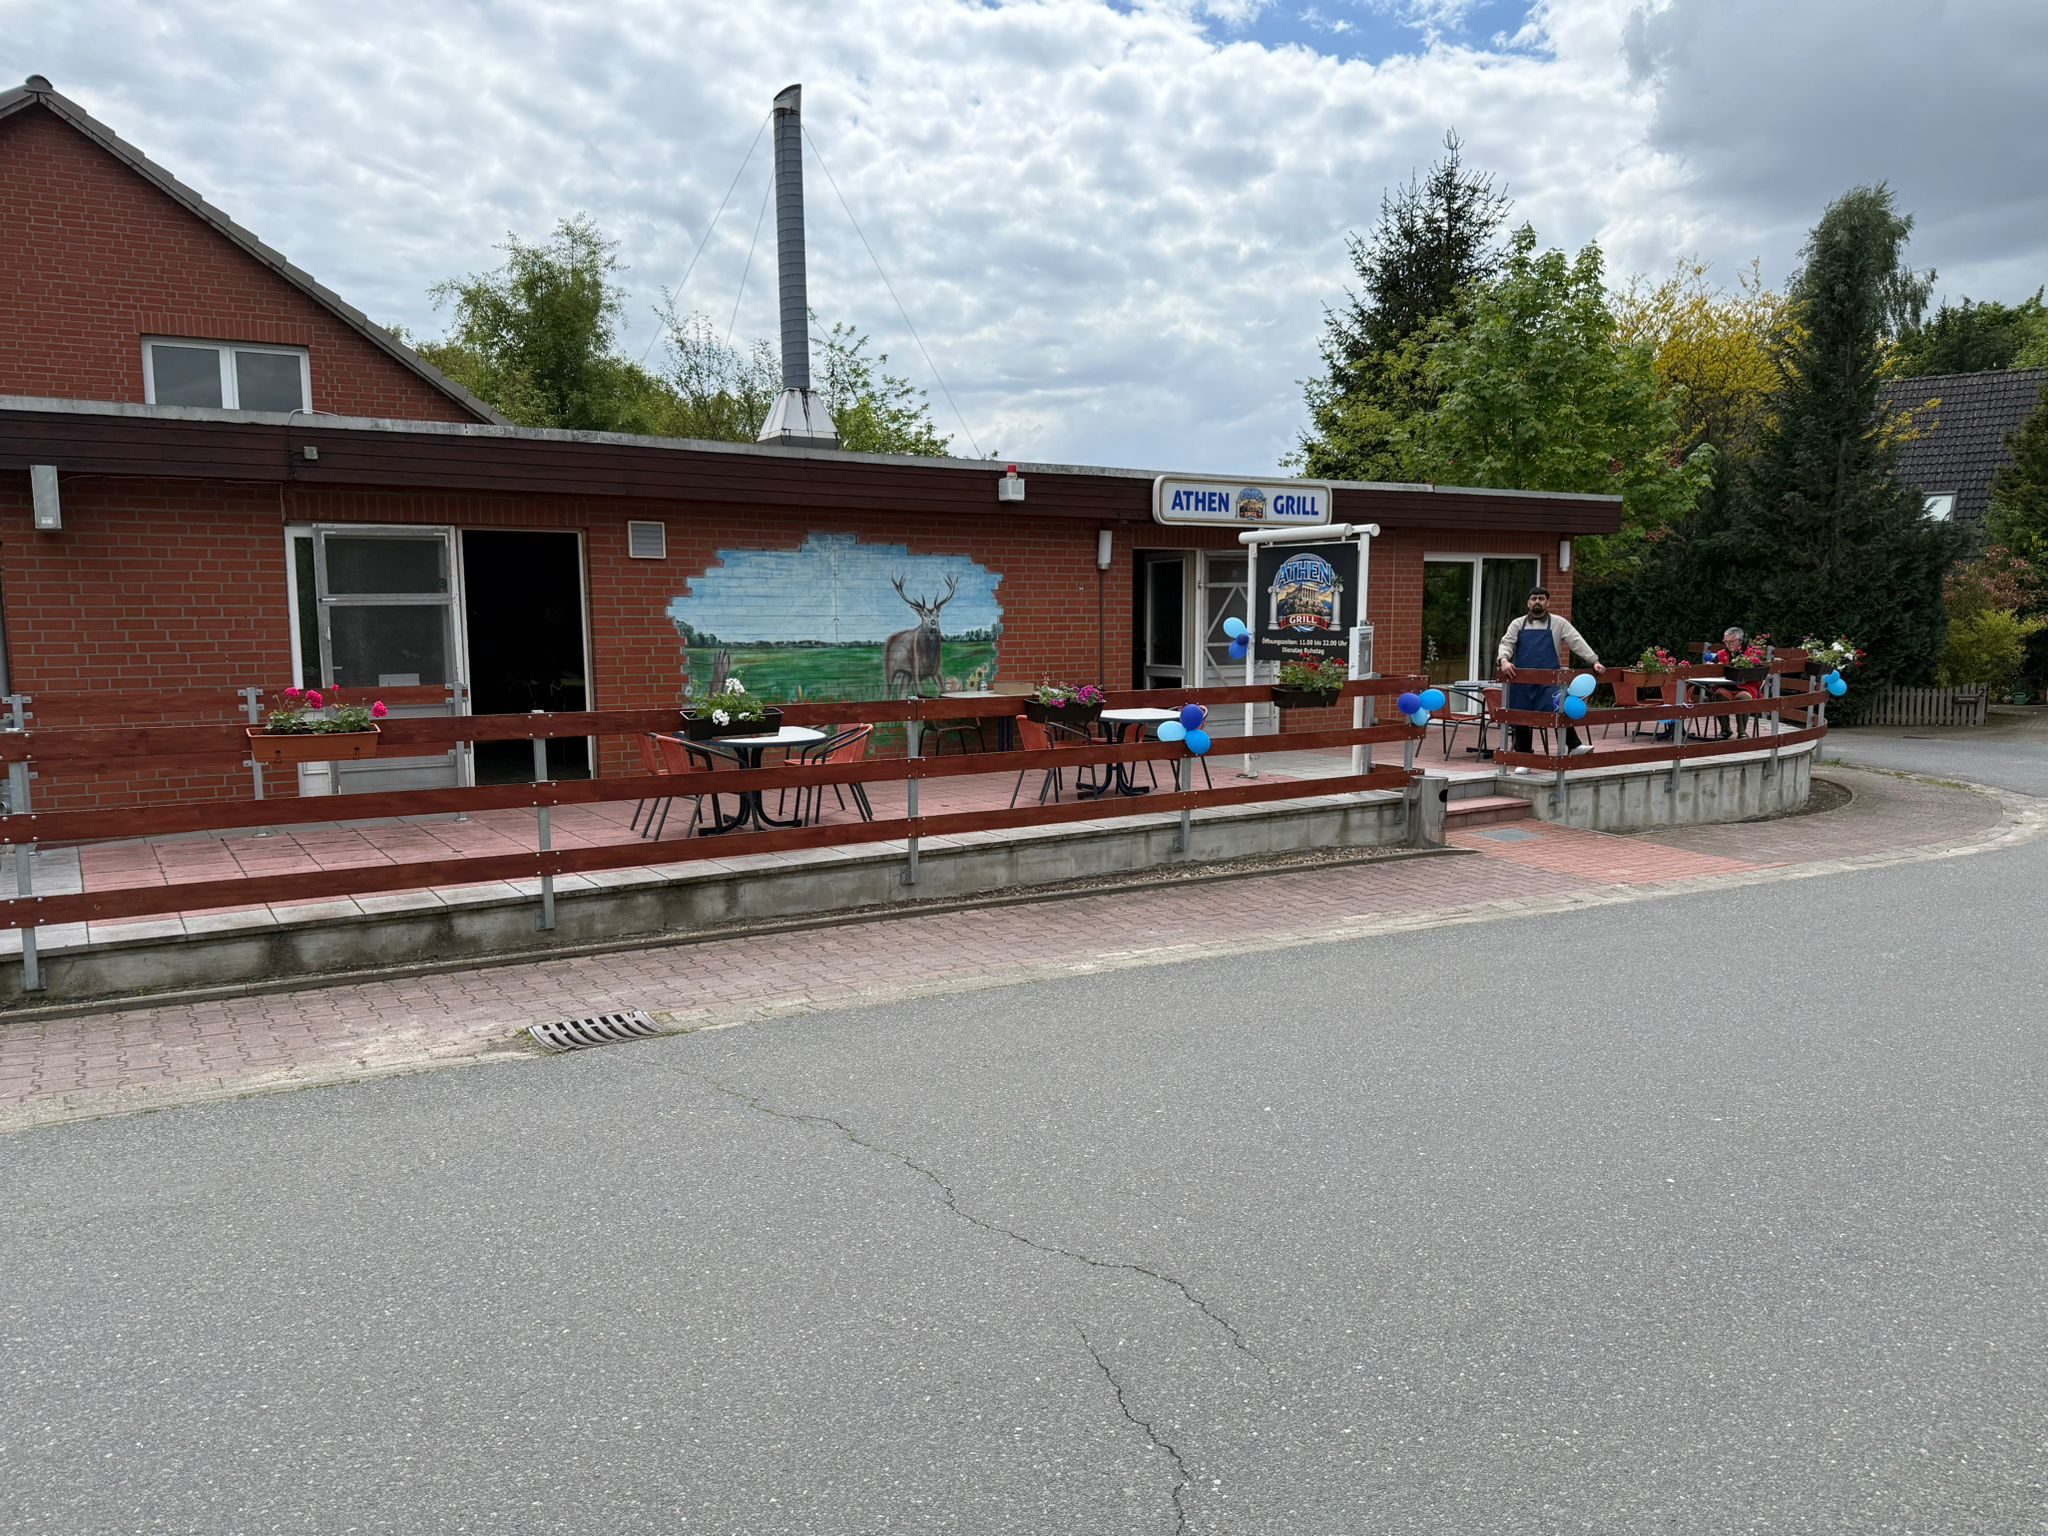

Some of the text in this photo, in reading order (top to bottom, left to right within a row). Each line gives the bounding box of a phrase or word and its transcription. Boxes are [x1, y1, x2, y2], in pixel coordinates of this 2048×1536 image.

[1171, 490, 1230, 512] ATHEN
[1273, 495, 1319, 516] GRILL
[1279, 560, 1332, 587] ATHEN
[1289, 615, 1318, 625] GRILL
